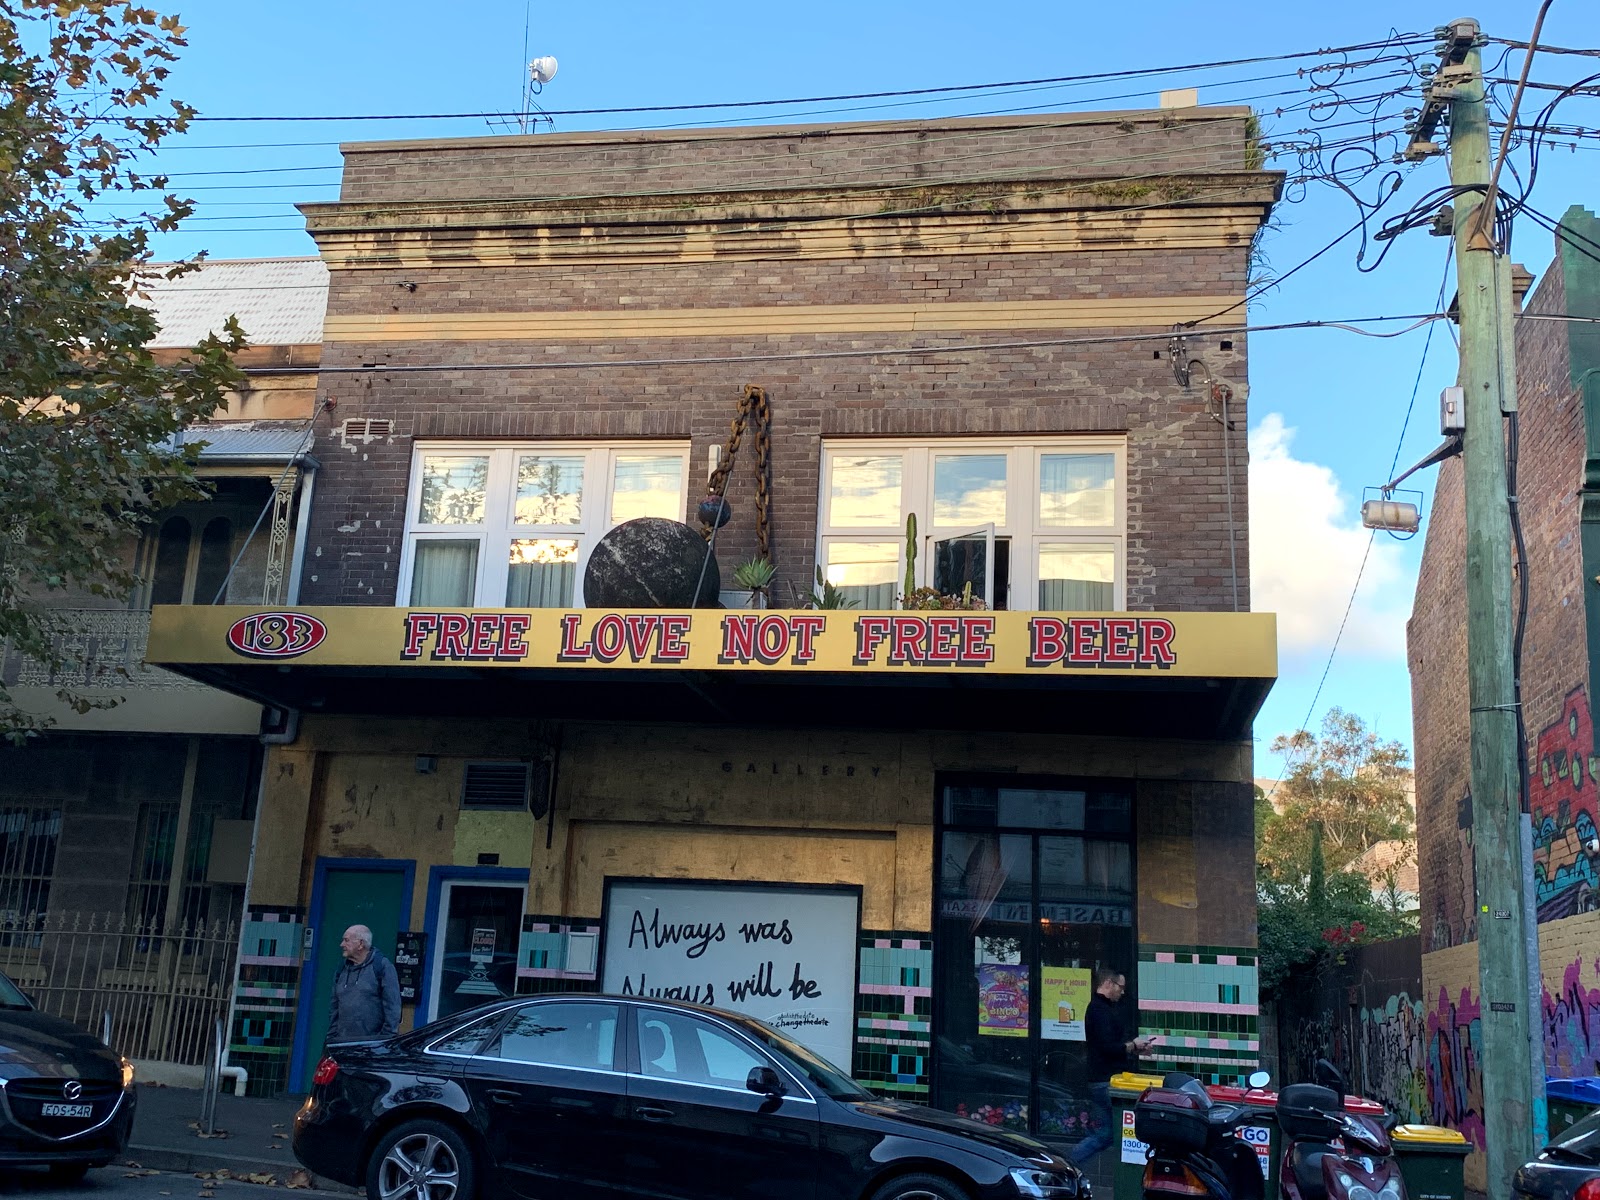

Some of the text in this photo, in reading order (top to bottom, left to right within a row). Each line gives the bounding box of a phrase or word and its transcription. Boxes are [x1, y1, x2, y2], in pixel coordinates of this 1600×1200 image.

[243, 616, 313, 650] 183
[401, 613, 1178, 669] FREE LOVE NOT FREE BEER
[722, 761, 881, 777] GALLERY
[628, 907, 793, 959] Always was
[728, 961, 782, 1003] will
[789, 962, 822, 1001] be
[1044, 978, 1088, 987] HAPPY HOUR
[990, 1007, 1019, 1017] BINGO
[1123, 1140, 1142, 1148] 1300
